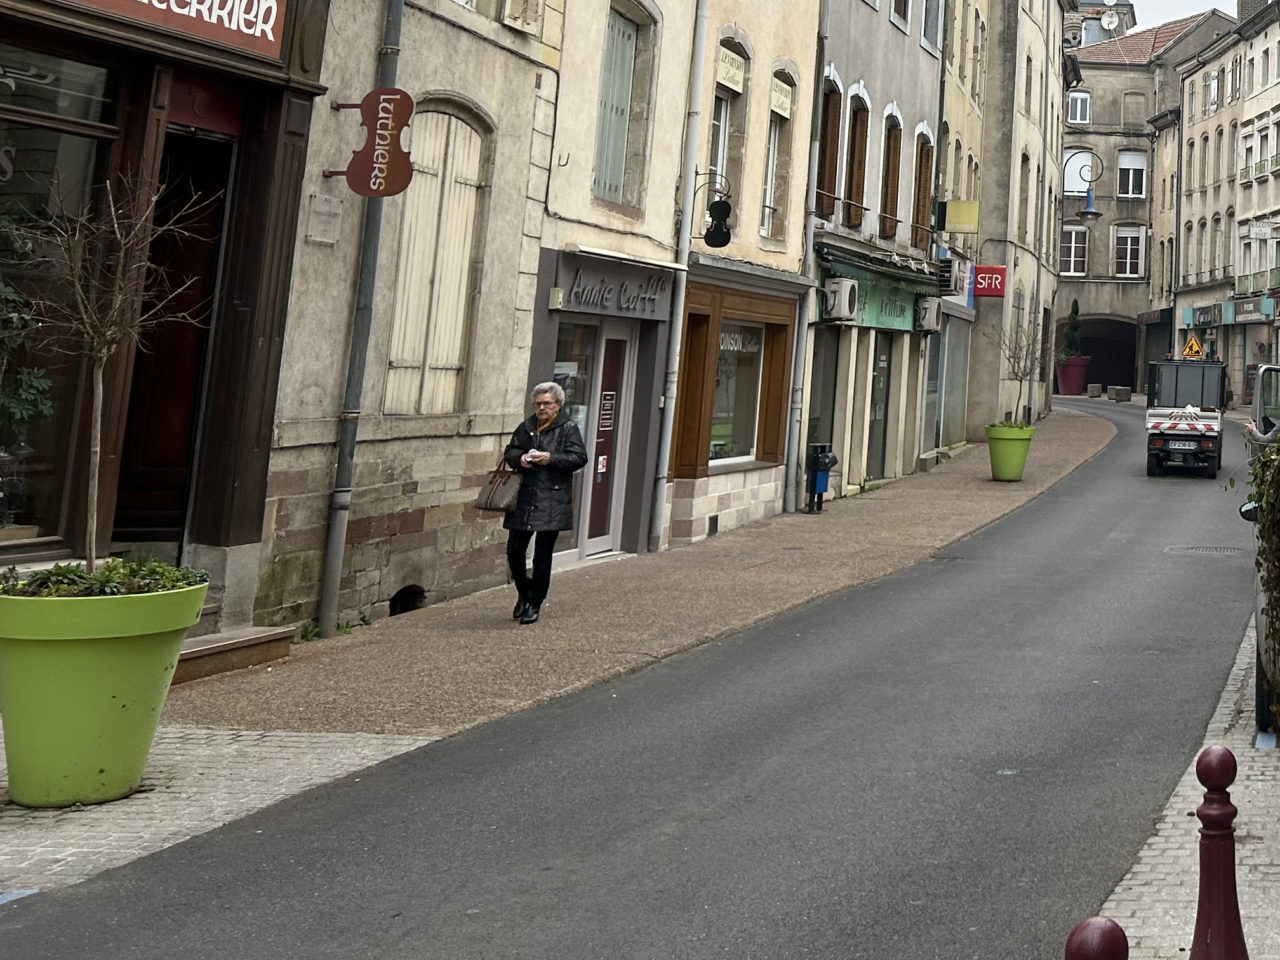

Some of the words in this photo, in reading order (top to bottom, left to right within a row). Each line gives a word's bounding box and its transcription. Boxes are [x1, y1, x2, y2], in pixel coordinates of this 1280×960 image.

[369, 94, 401, 191] Luthiers
[568, 267, 616, 308] Annie
[976, 273, 1002, 289] SFR
